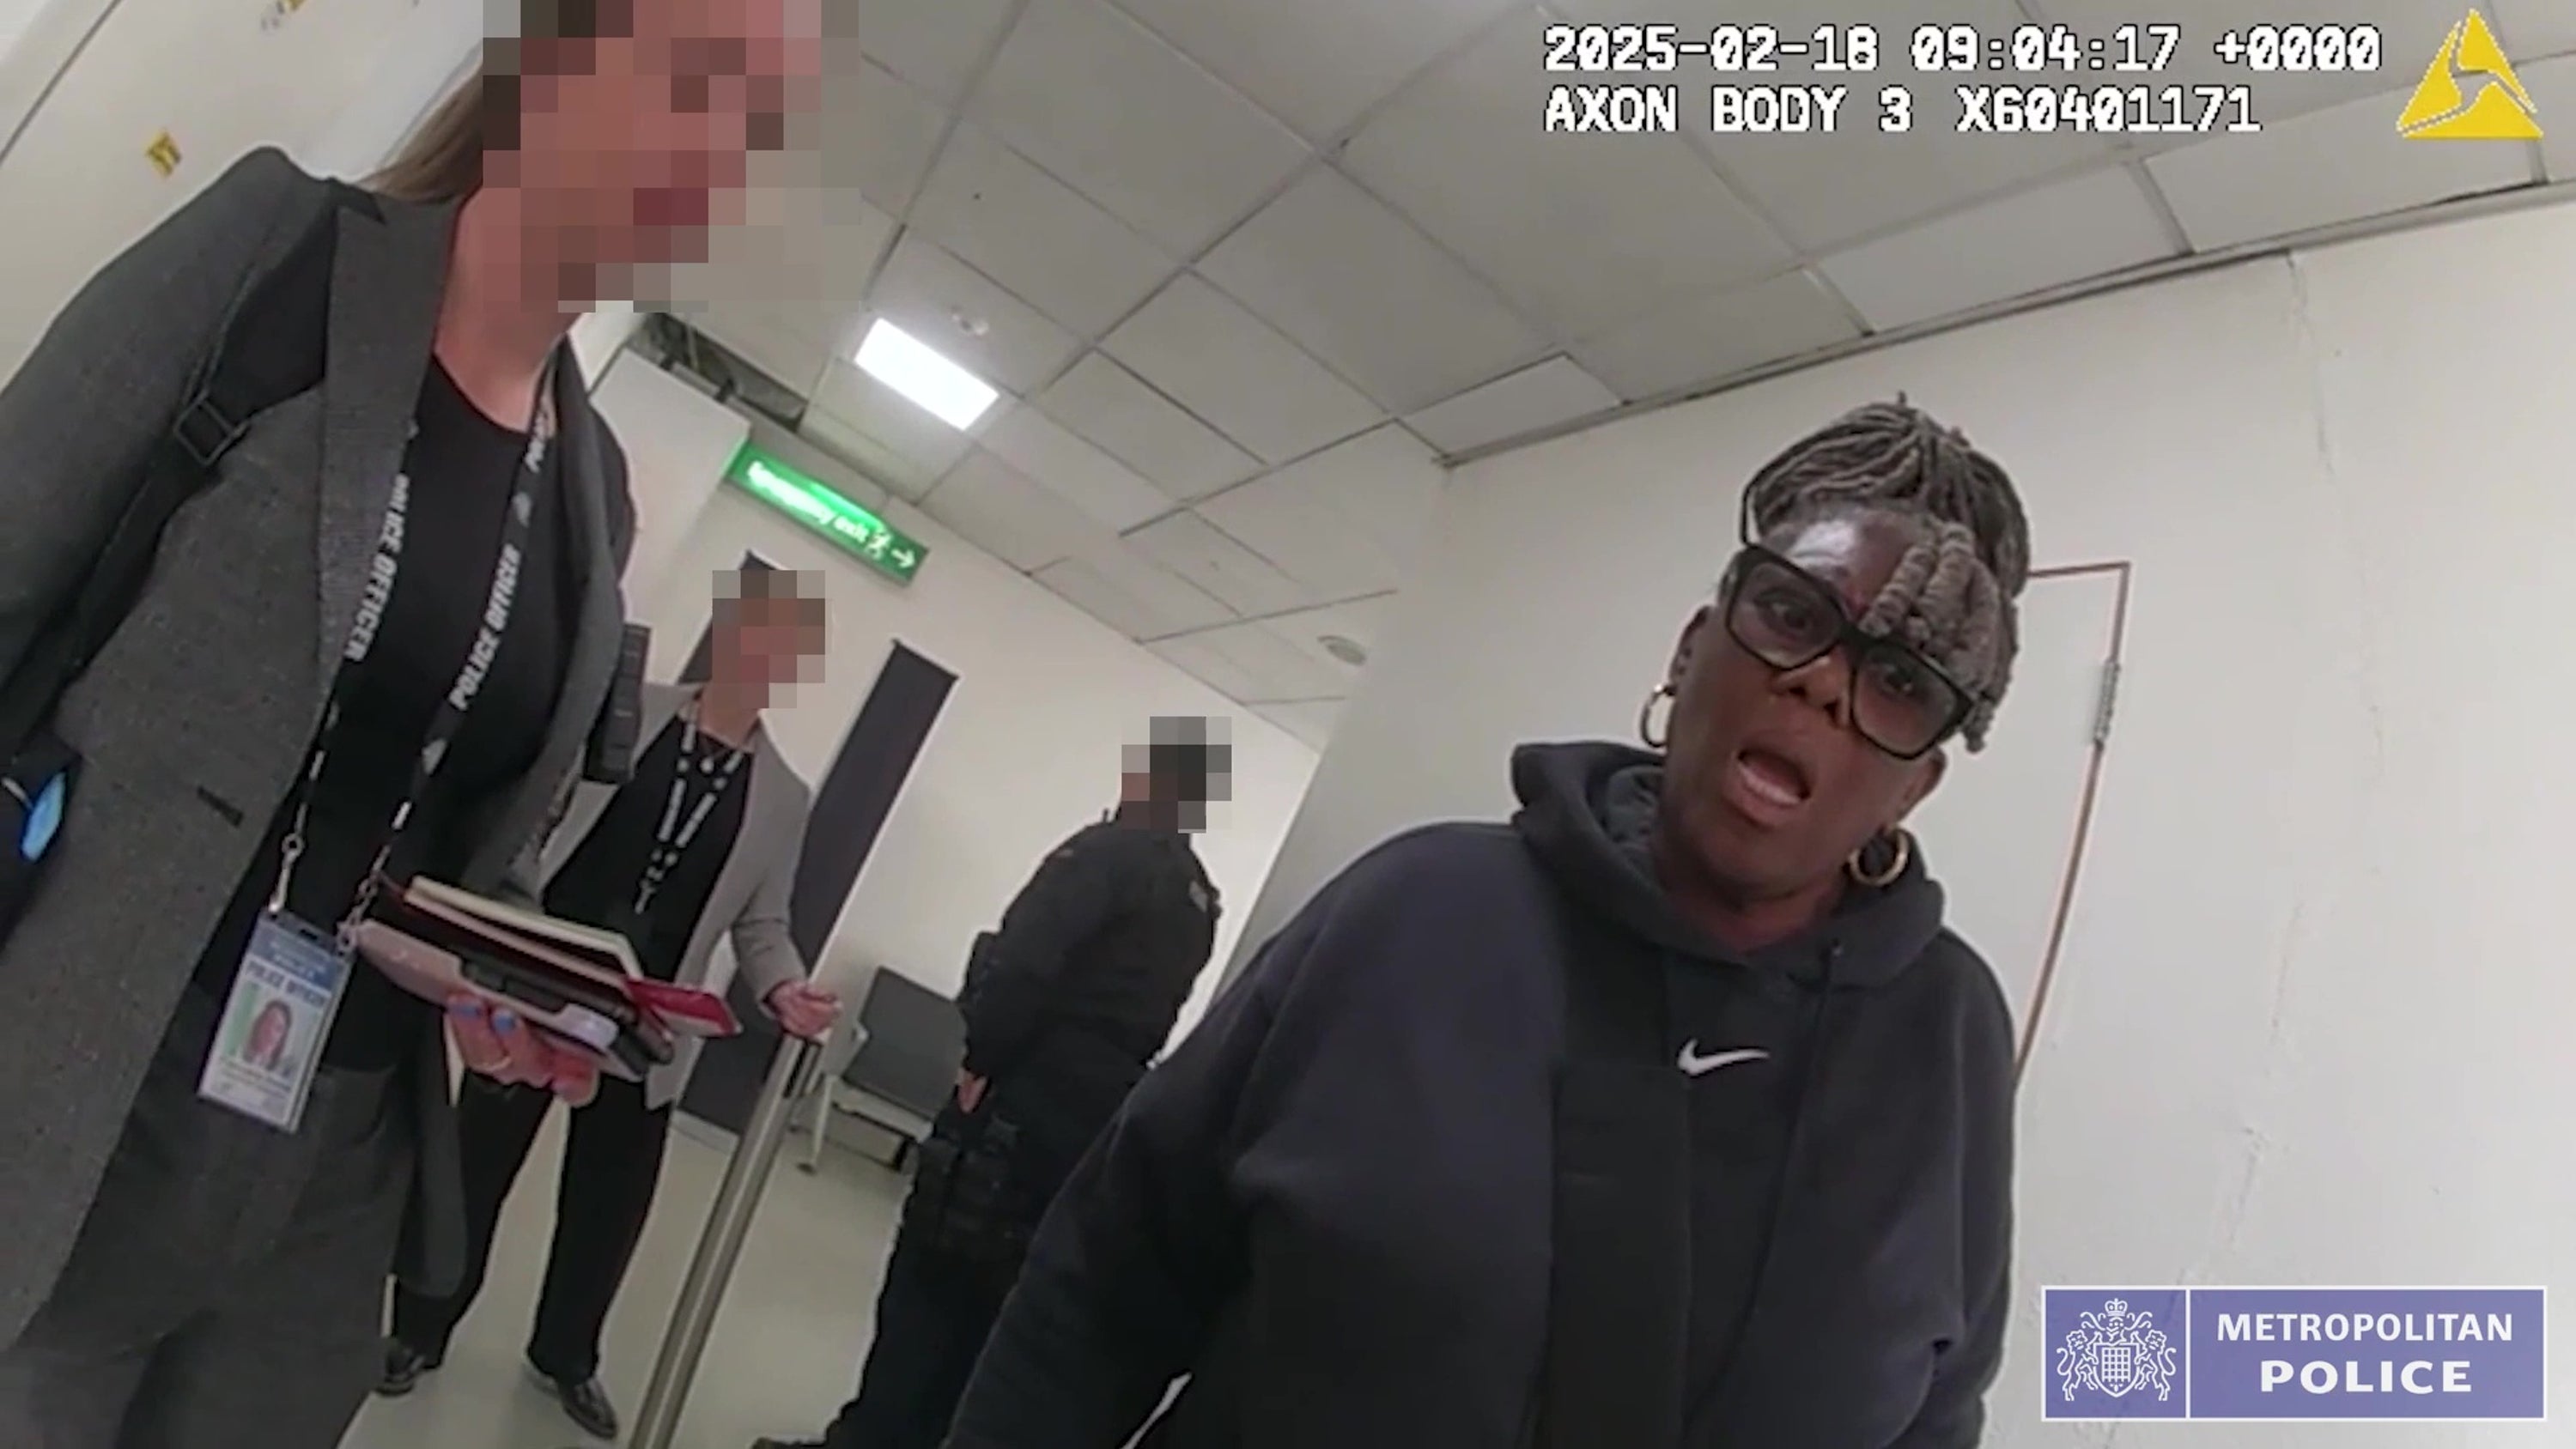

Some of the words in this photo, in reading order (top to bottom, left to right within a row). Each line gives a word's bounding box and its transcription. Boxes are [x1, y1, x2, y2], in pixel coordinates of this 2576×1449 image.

[344, 552, 398, 662] OFFICER
[448, 625, 501, 712] POLICE
[484, 543, 521, 631] OFFICER
